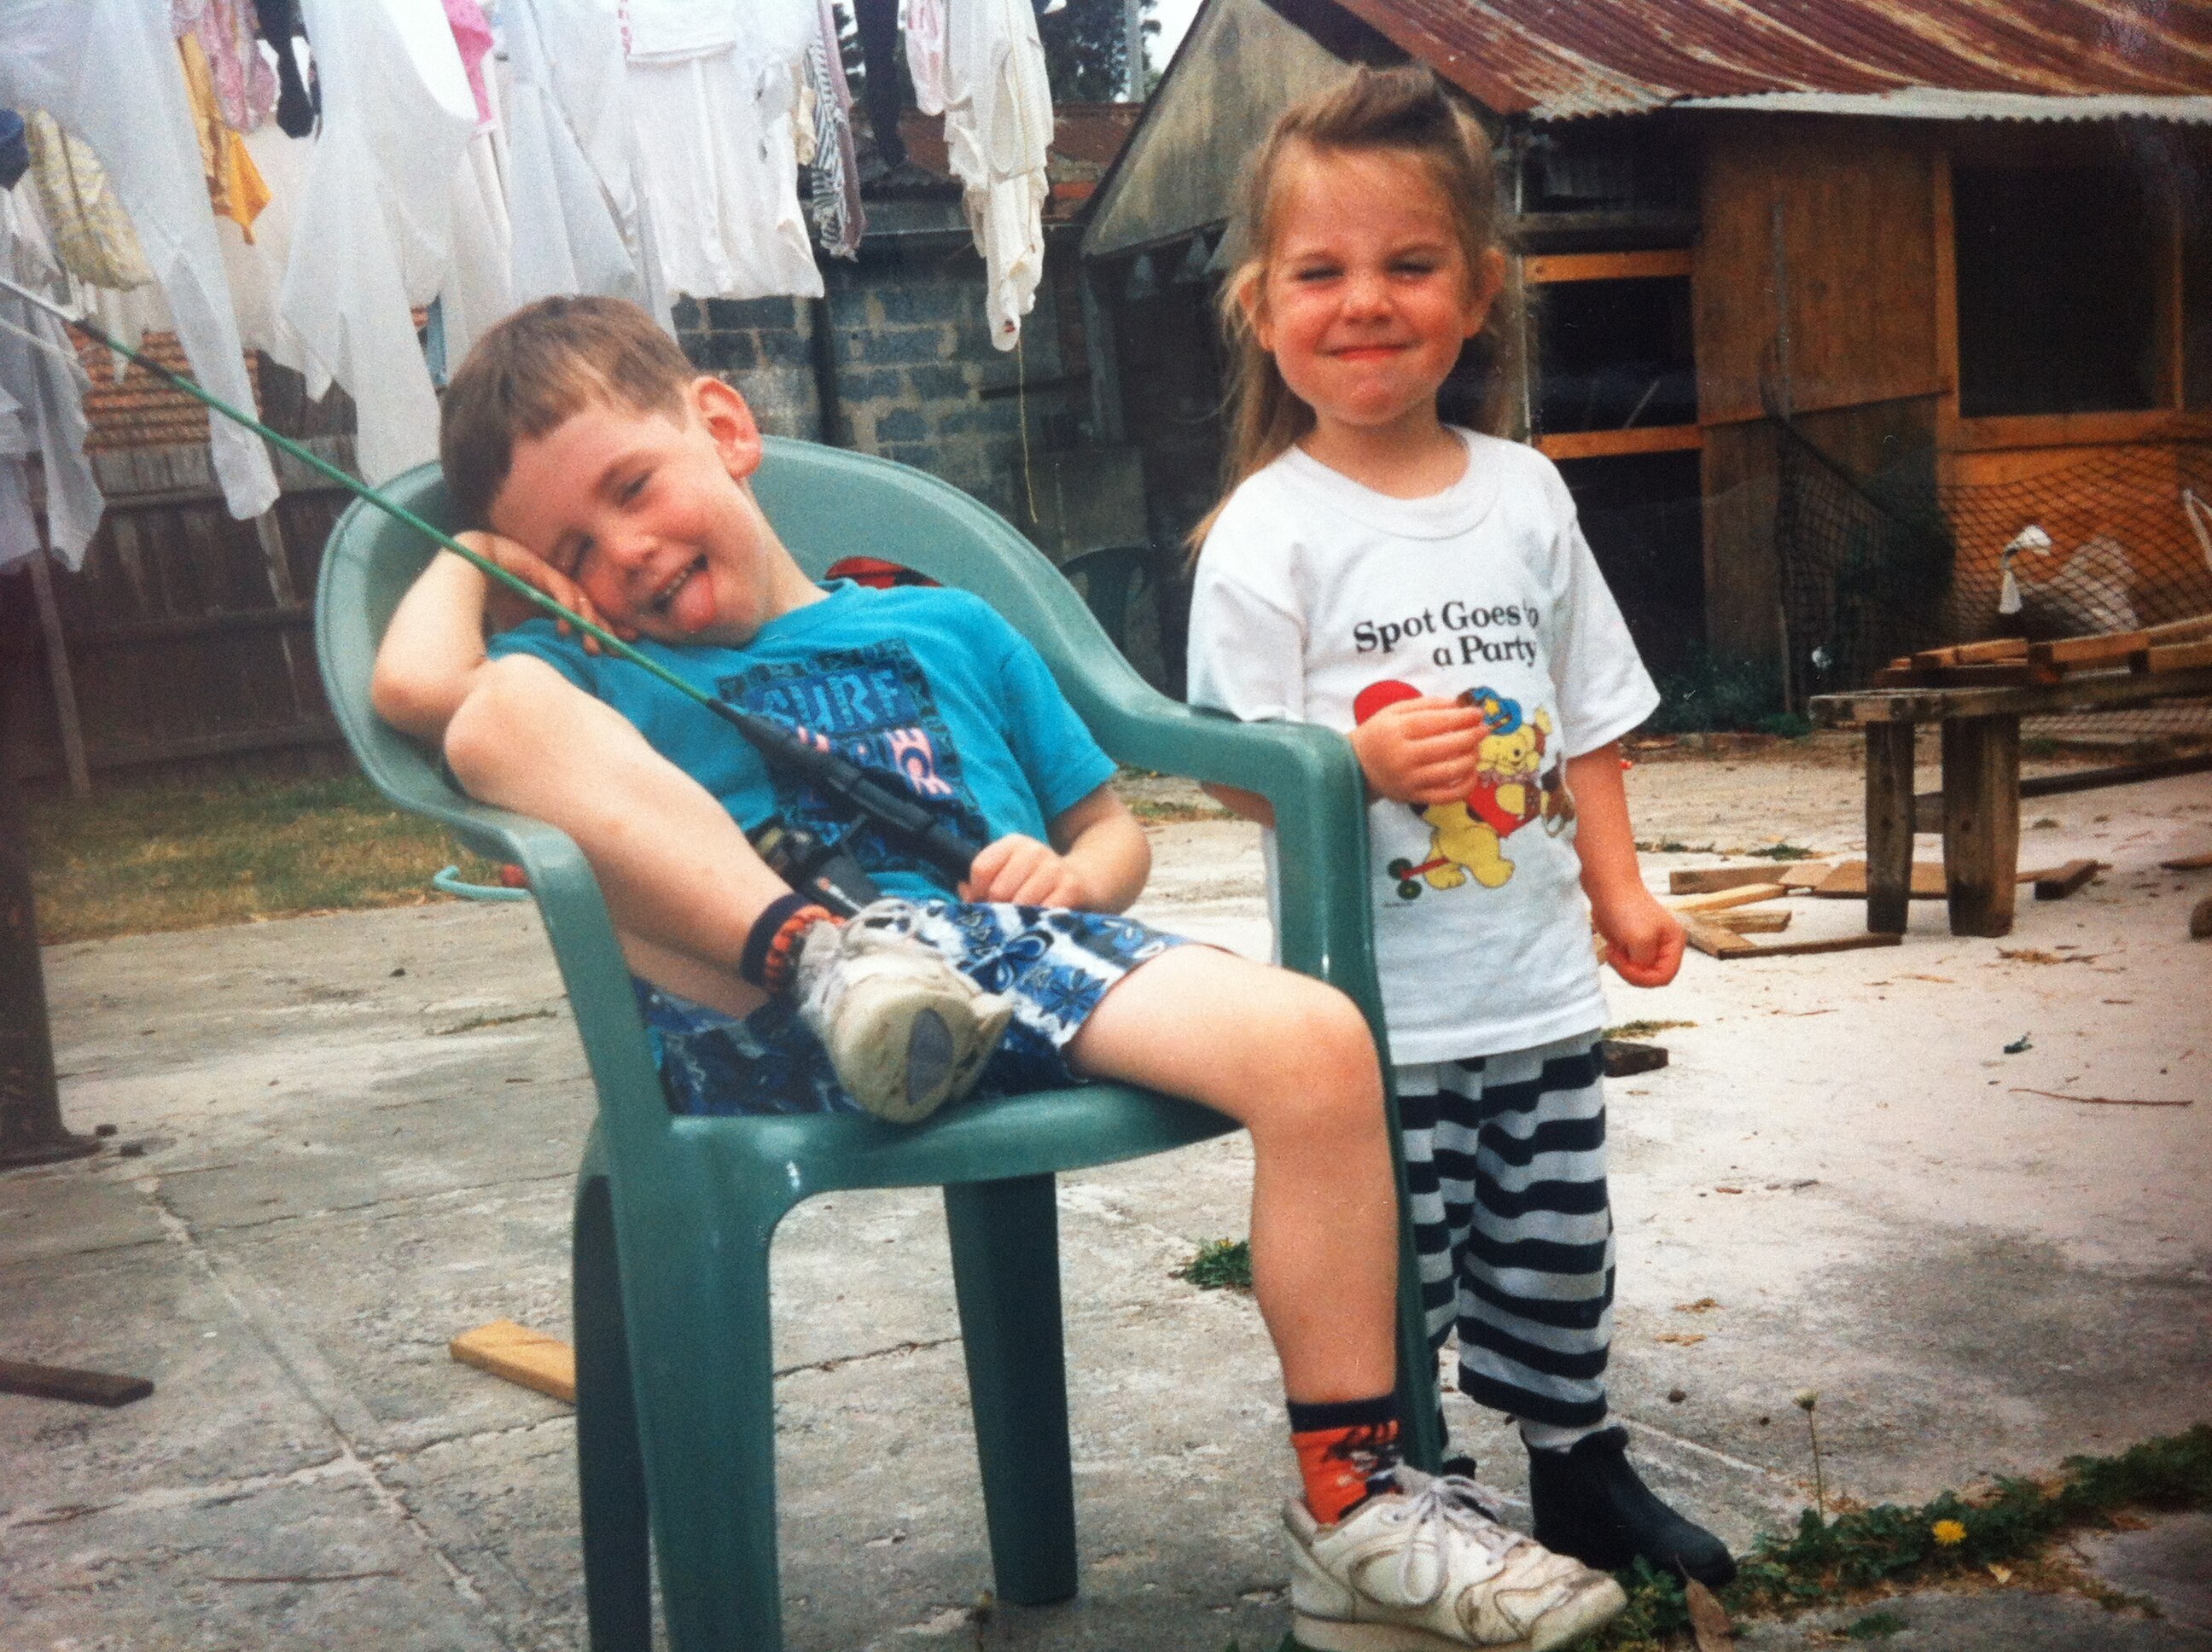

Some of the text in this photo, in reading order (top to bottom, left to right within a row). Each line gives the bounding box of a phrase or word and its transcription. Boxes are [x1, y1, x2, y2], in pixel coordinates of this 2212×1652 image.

[1352, 607, 1437, 654] Spot
[1441, 600, 1522, 631] Goes
[1433, 635, 1536, 667] a Party
[763, 668, 899, 732] SURF
